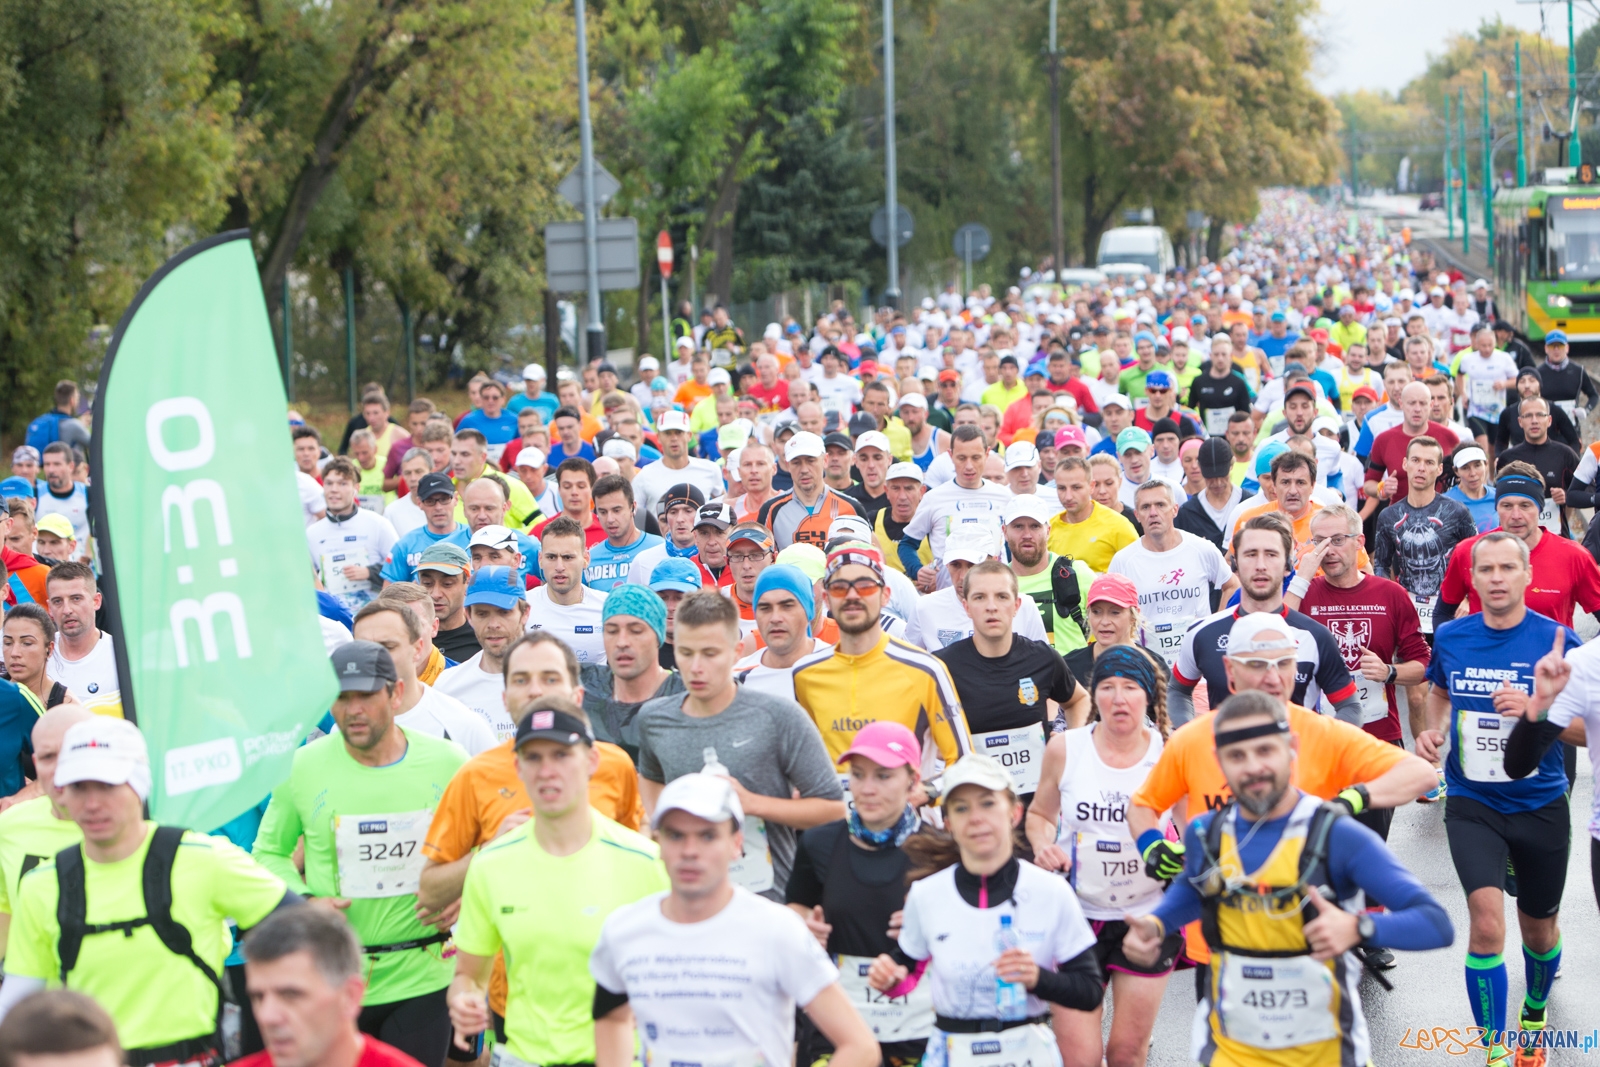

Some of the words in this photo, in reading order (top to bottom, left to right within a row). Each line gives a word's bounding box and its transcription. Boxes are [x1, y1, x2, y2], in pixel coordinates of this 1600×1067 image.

[1156, 605, 1183, 615] biega
[1327, 604, 1346, 612] BIEG
[1346, 603, 1387, 612] LECHITÓW
[1464, 667, 1519, 681] RUNNERS
[358, 840, 417, 862] 3247
[1100, 859, 1139, 877] 1718
[1242, 988, 1309, 1009] 4873
